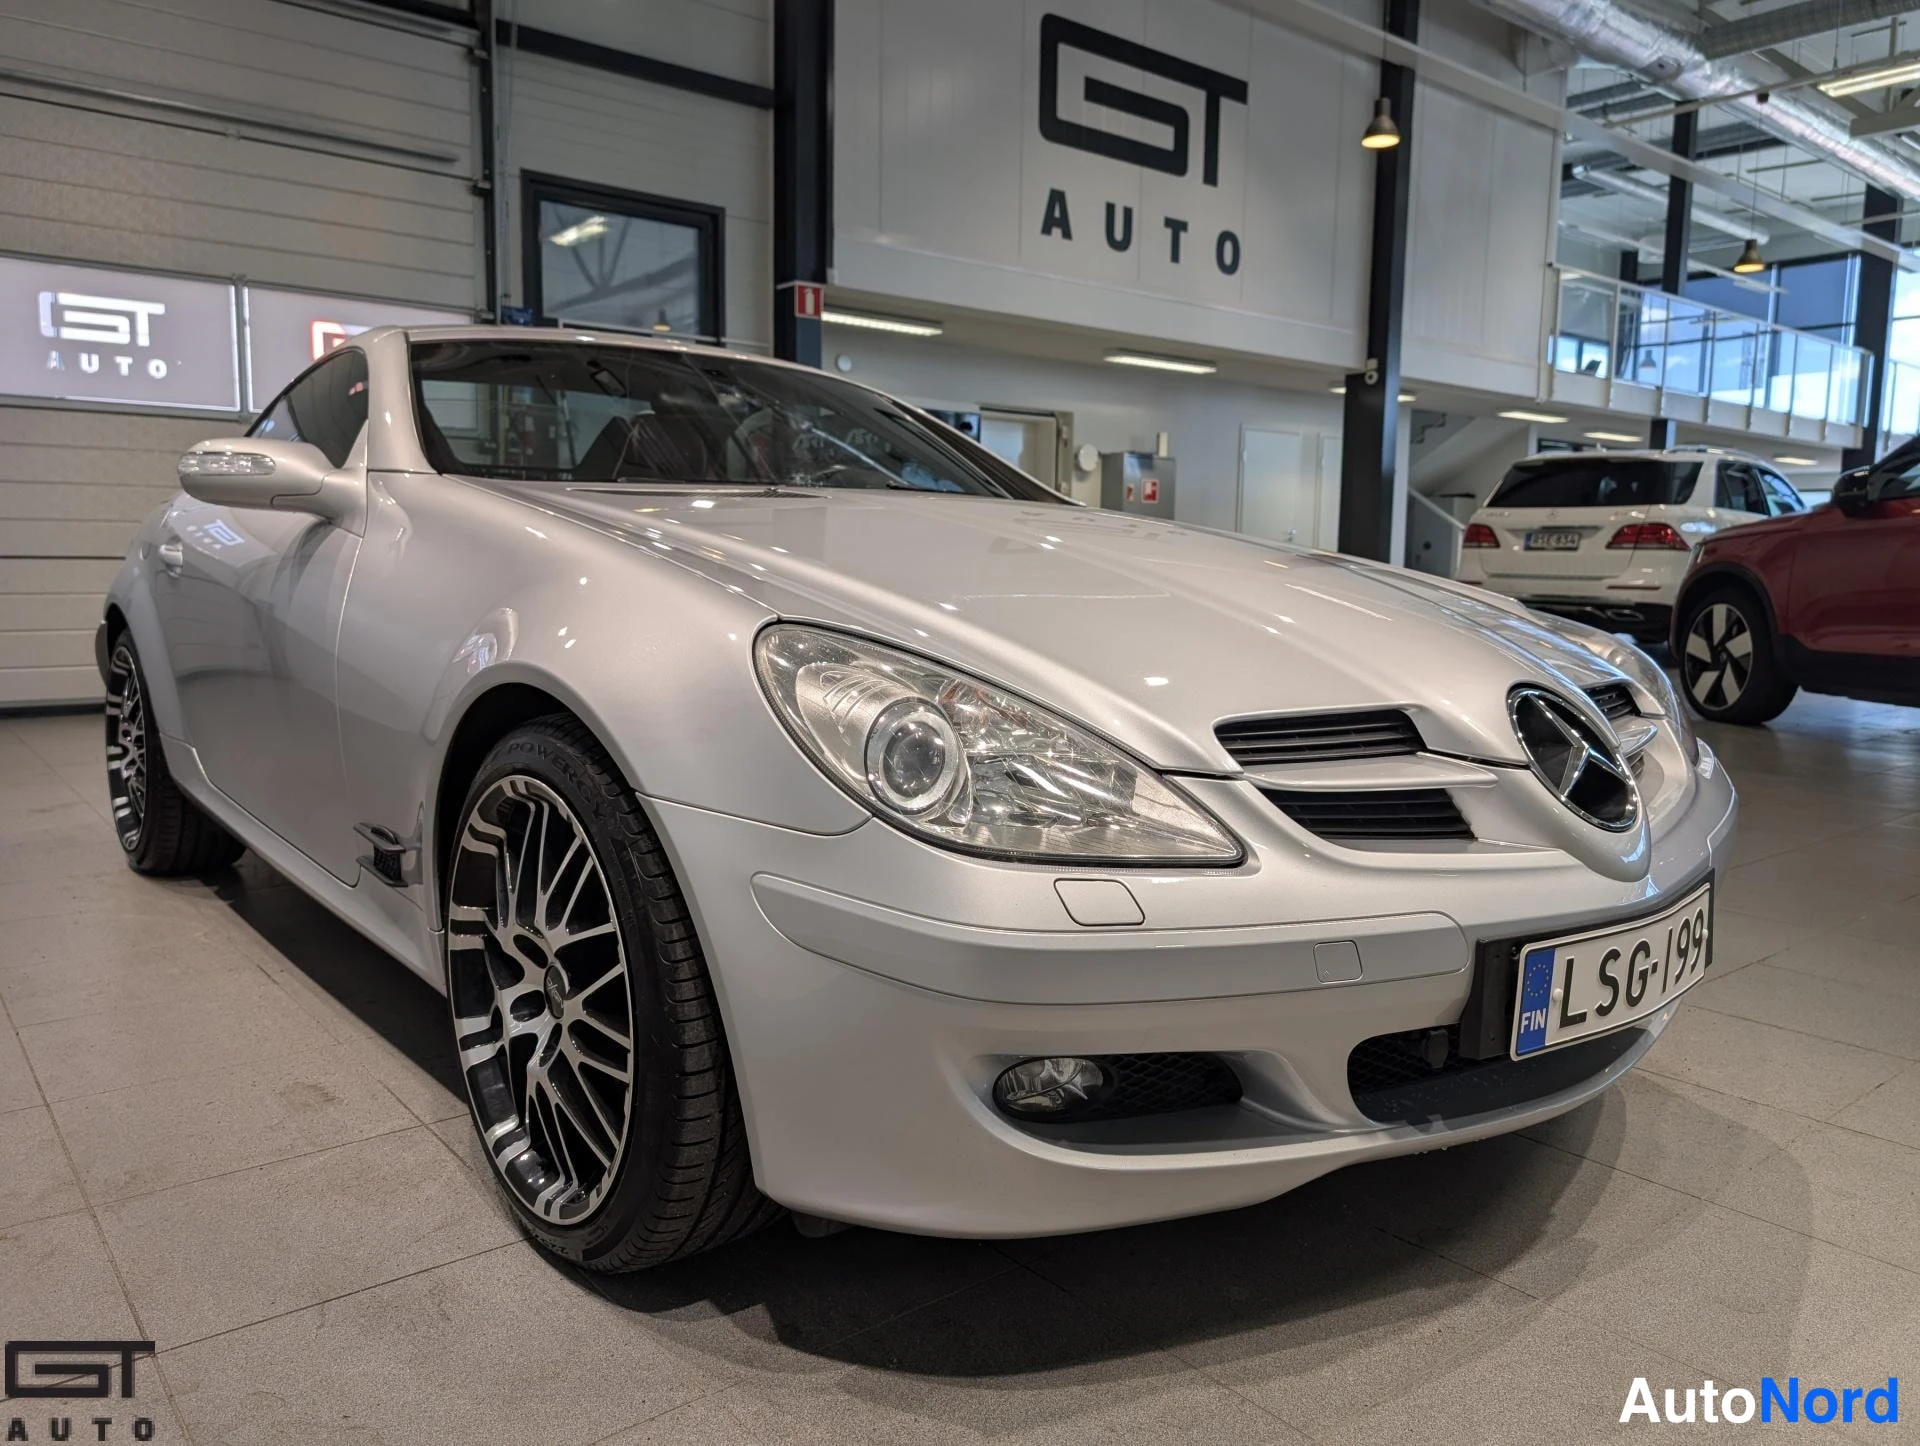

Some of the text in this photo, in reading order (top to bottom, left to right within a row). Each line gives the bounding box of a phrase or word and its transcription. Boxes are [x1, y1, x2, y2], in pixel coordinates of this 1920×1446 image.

[1039, 13, 1248, 188] GT
[1041, 188, 1241, 275] AUTO
[46, 352, 168, 380] AUTO
[1559, 907, 1705, 1028] LSG-199
[1520, 1008, 1547, 1034] FIN
